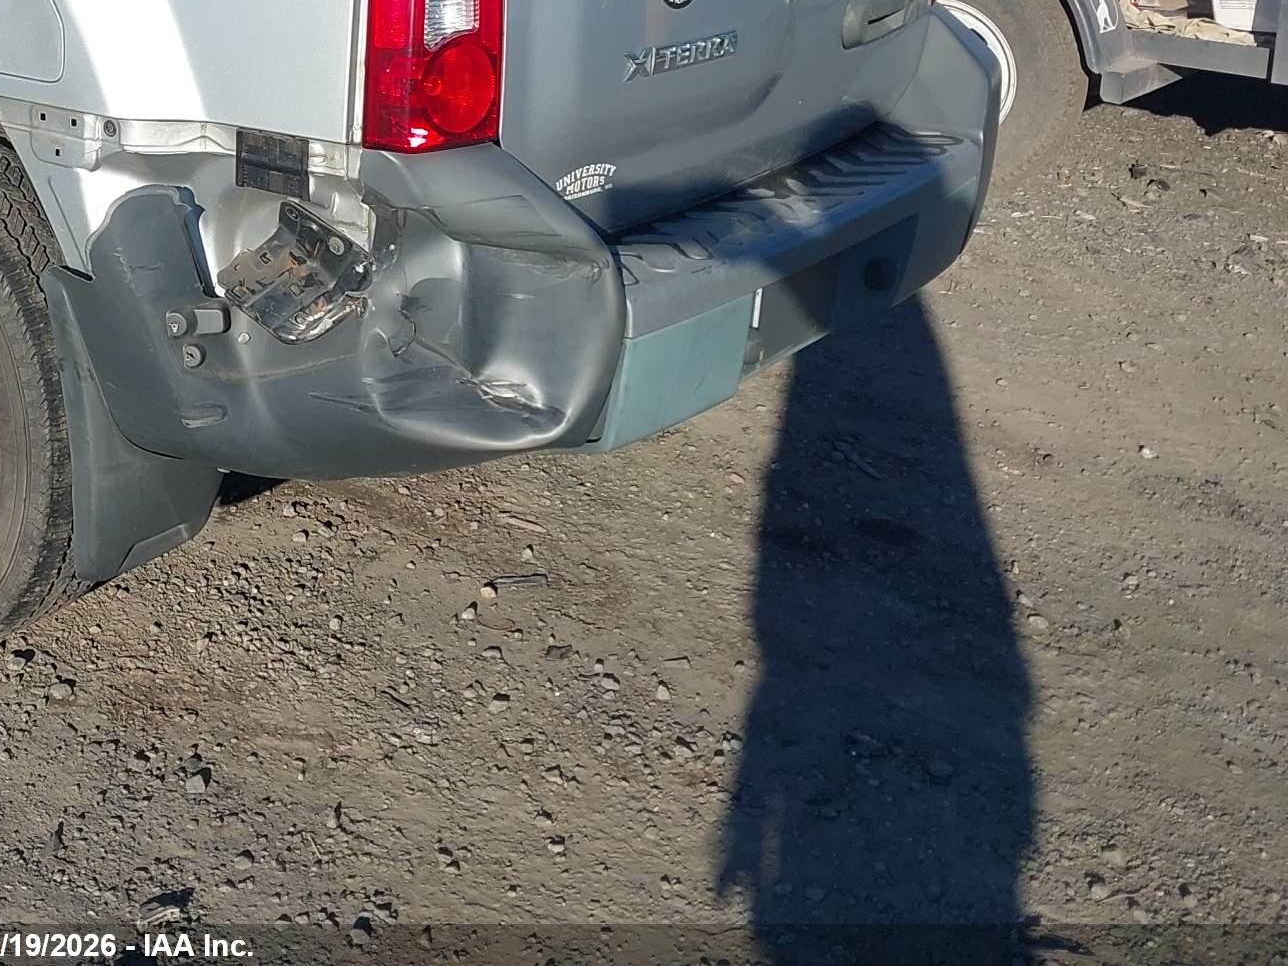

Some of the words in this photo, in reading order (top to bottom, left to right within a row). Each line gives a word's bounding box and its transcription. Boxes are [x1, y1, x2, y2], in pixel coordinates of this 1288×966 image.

[623, 33, 736, 82] XTERRA
[556, 163, 617, 191] UNIVERSITY
[566, 175, 605, 195] MOTORS
